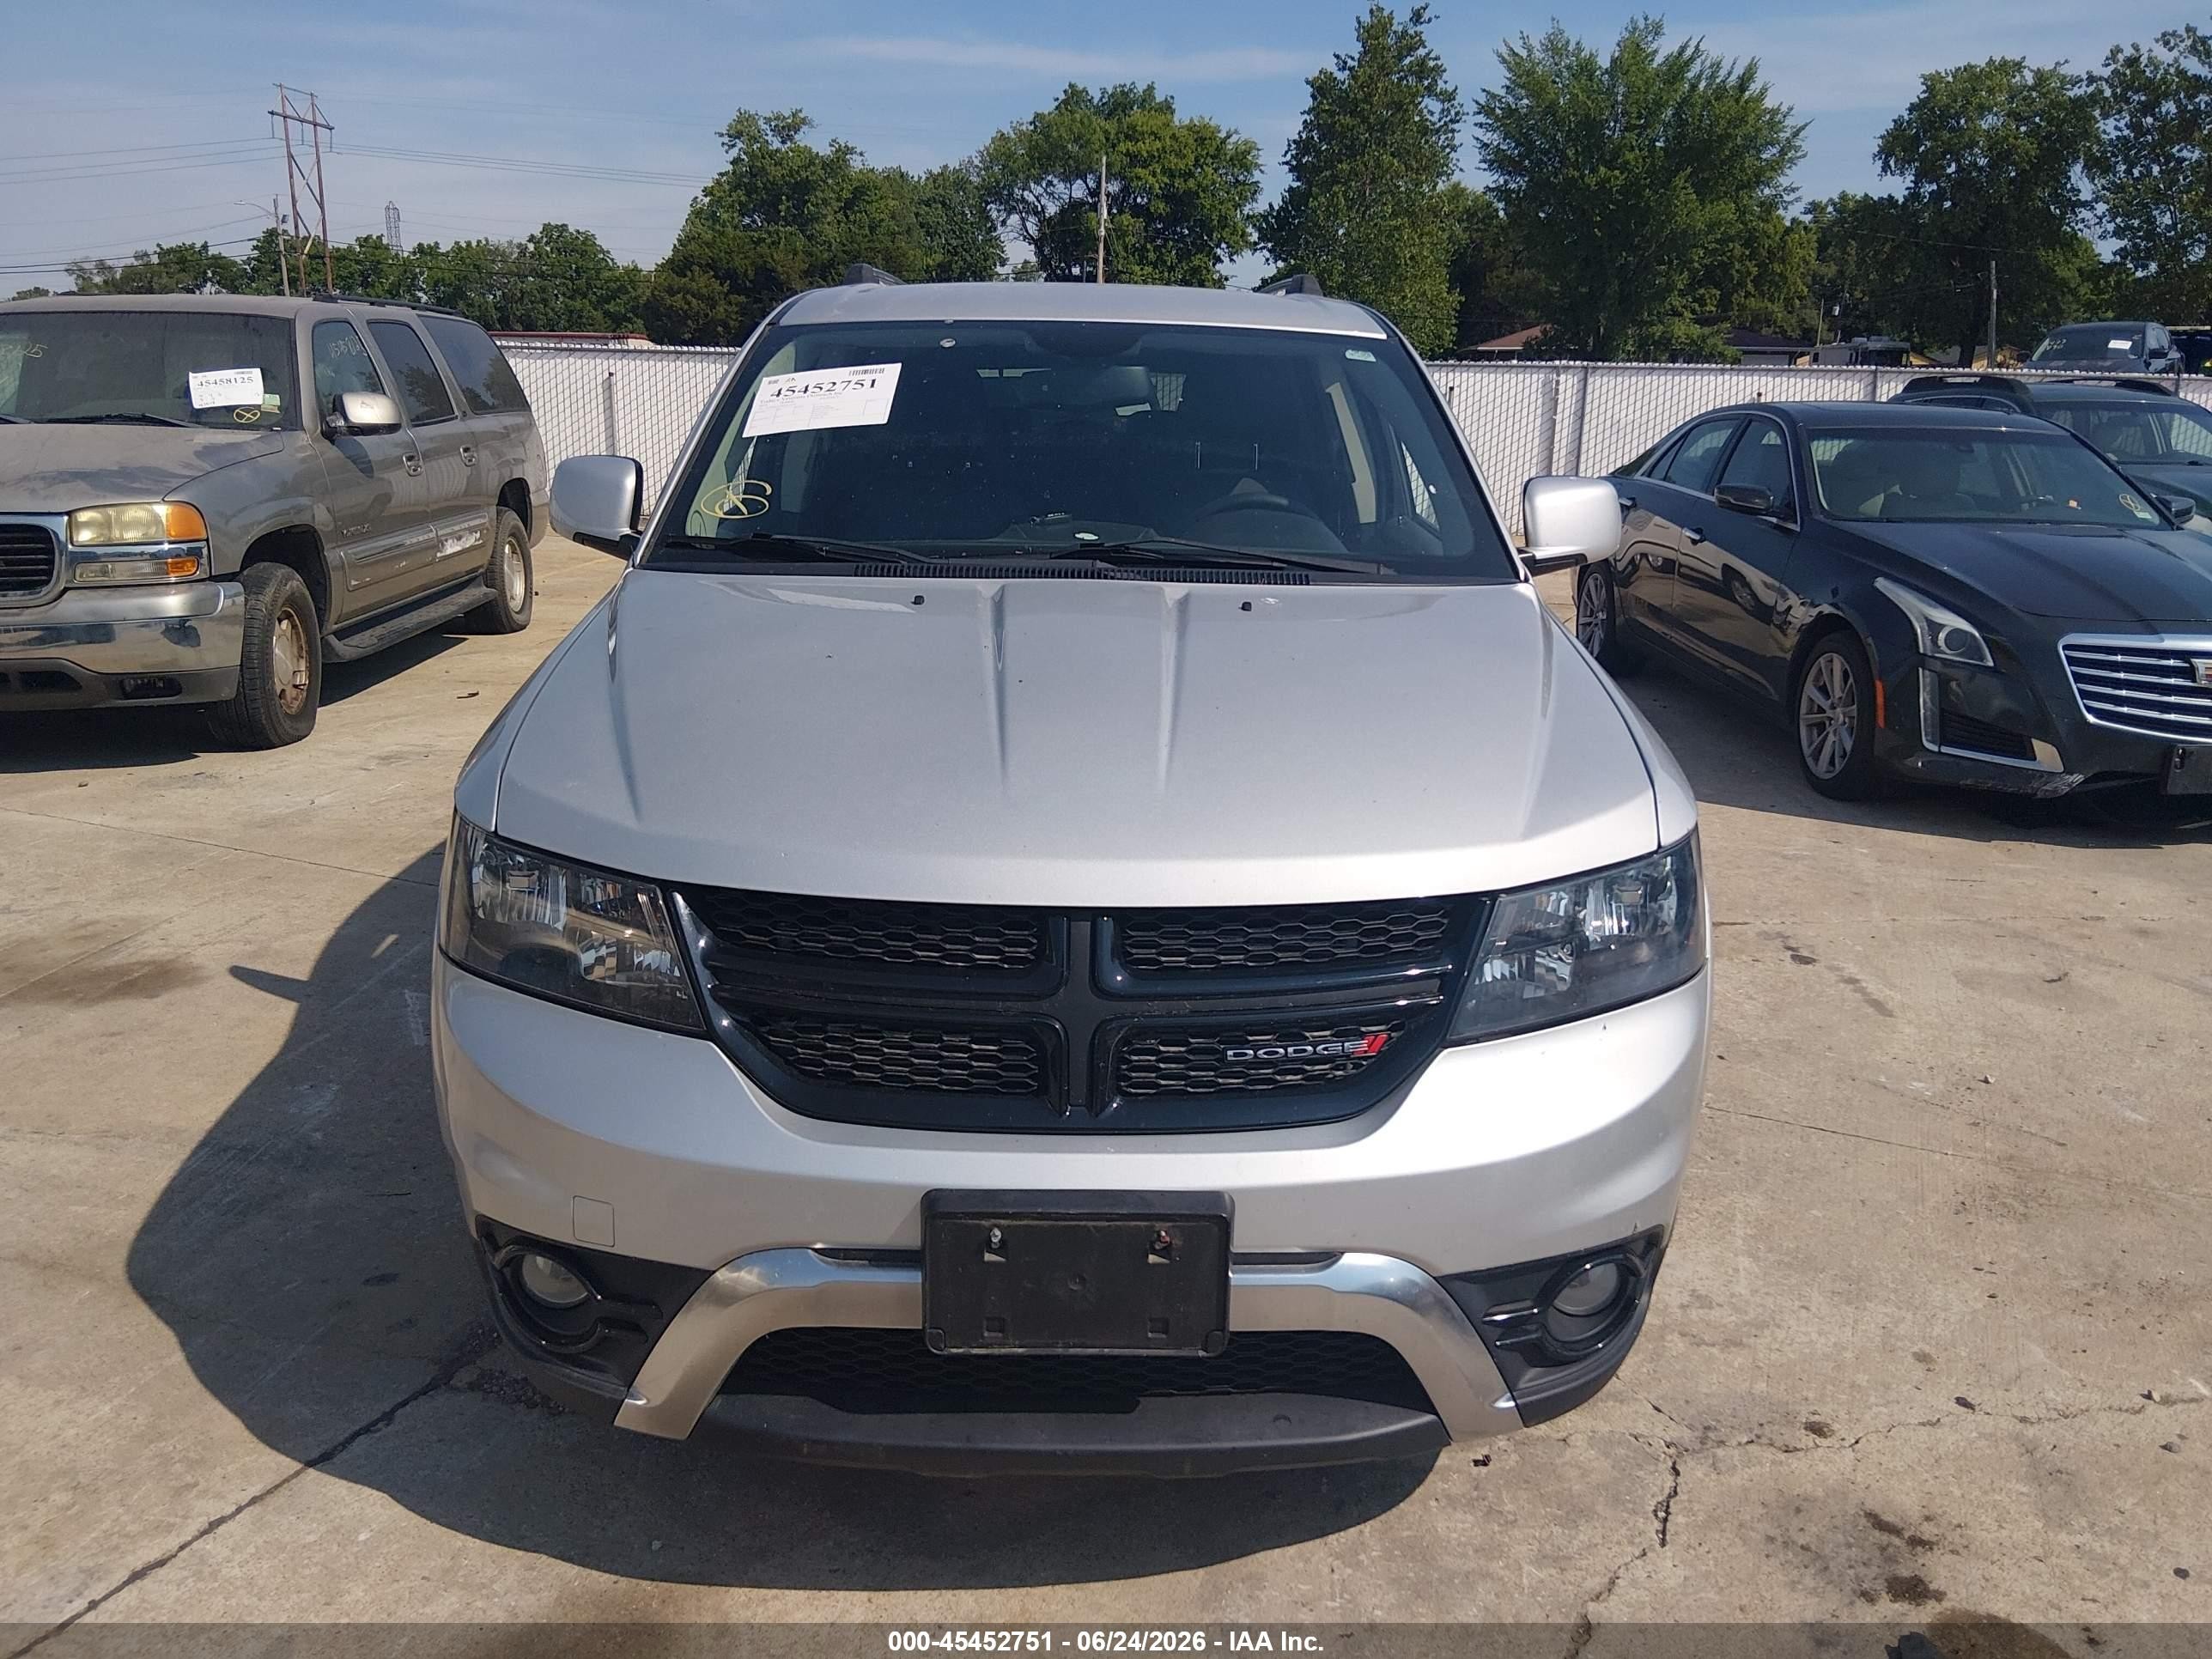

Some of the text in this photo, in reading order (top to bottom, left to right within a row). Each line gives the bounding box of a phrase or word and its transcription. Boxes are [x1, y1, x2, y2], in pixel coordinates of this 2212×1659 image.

[198, 376, 254, 387] 45458125
[770, 378, 877, 398] 45452751
[1226, 1039, 1369, 1060] DODGE
